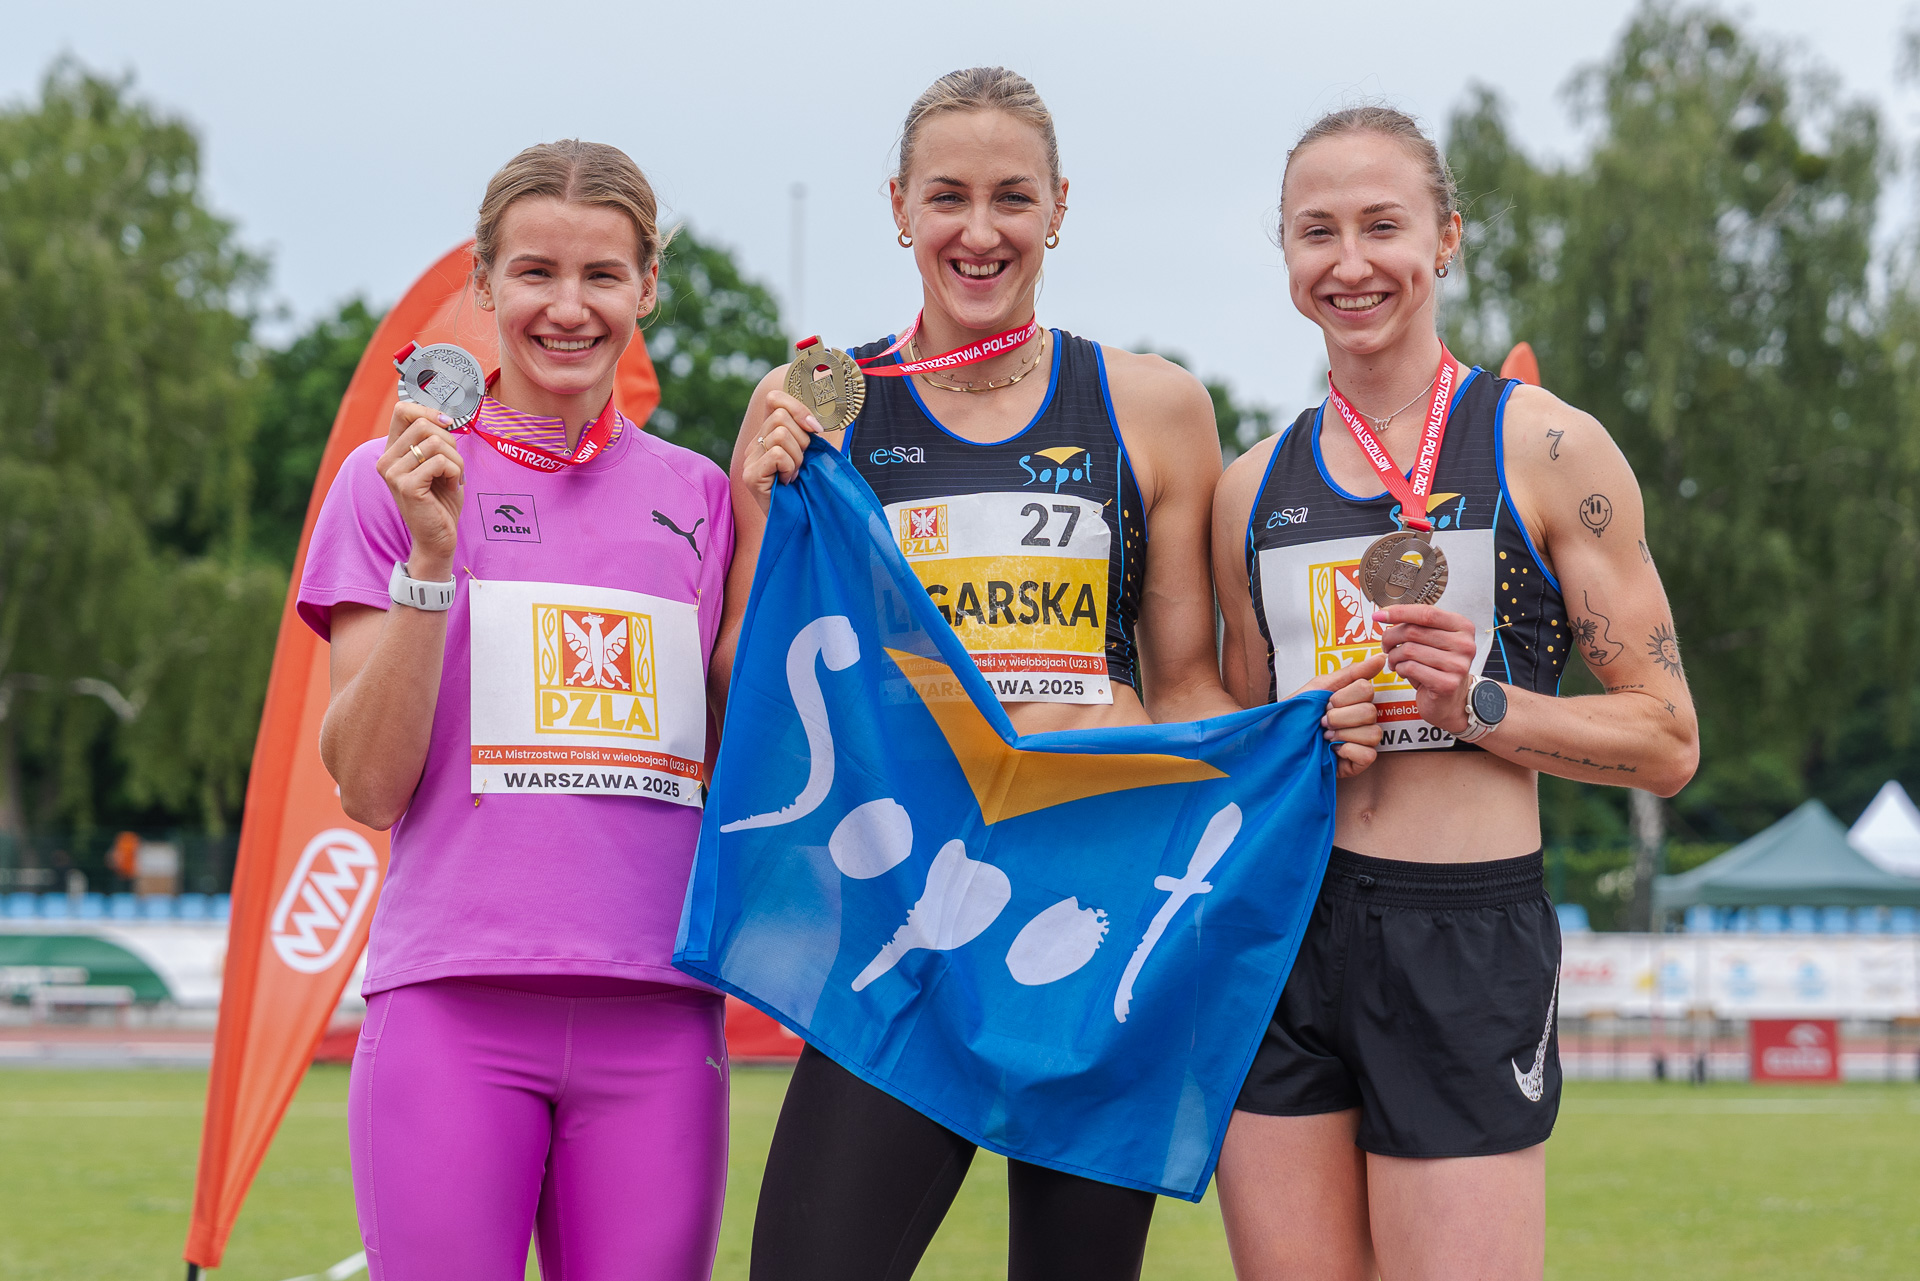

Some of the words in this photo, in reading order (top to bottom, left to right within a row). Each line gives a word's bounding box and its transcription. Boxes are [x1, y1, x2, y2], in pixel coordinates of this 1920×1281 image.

[899, 346, 982, 373] MISTRZOSTWA
[982, 329, 1025, 355] POLSKI
[1332, 391, 1355, 423] POLSKI
[1426, 363, 1454, 438] MISTRZOSTWA
[1350, 416, 1393, 472] MISTRZOSTWA
[1417, 437, 1437, 474] POLSKI
[1018, 452, 1093, 494] Sopot
[1412, 474, 1429, 496] 2025
[493, 524, 531, 535] ORLEN
[1020, 502, 1081, 548] 27
[1389, 496, 1467, 531] Sot
[903, 538, 946, 555] PZLA
[998, 659, 1008, 667] w
[1009, 657, 1066, 669] wielobojach
[1069, 656, 1087, 669] (U23
[1039, 679, 1085, 696] 2025
[542, 690, 653, 733] PZLA
[478, 749, 503, 759] PZLA
[505, 749, 568, 759] Mistrzostwa
[570, 750, 600, 760] Polski
[613, 752, 668, 767] wielobojach
[669, 758, 684, 771] (U23
[685, 764, 689, 772] i
[690, 763, 698, 776] S)
[504, 772, 638, 790] WARSZAWA
[643, 776, 680, 797] 2025
[720, 615, 1242, 1023] Sopot
